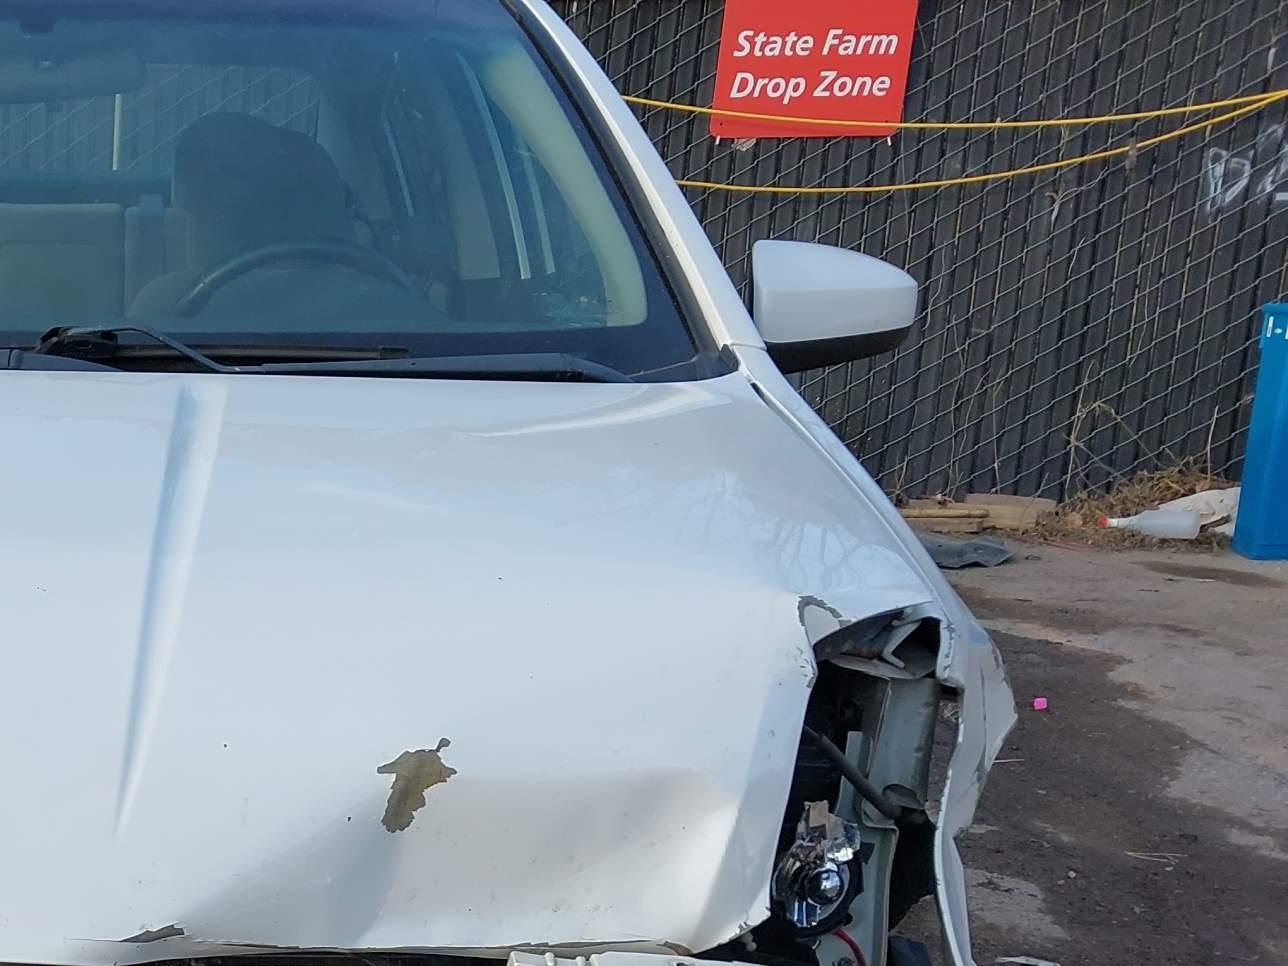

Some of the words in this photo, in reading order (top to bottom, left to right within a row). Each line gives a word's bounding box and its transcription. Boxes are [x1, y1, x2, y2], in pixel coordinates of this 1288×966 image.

[733, 30, 814, 57] State
[822, 29, 898, 56] Farm
[730, 72, 805, 104] Drop
[813, 71, 891, 97] Zone
